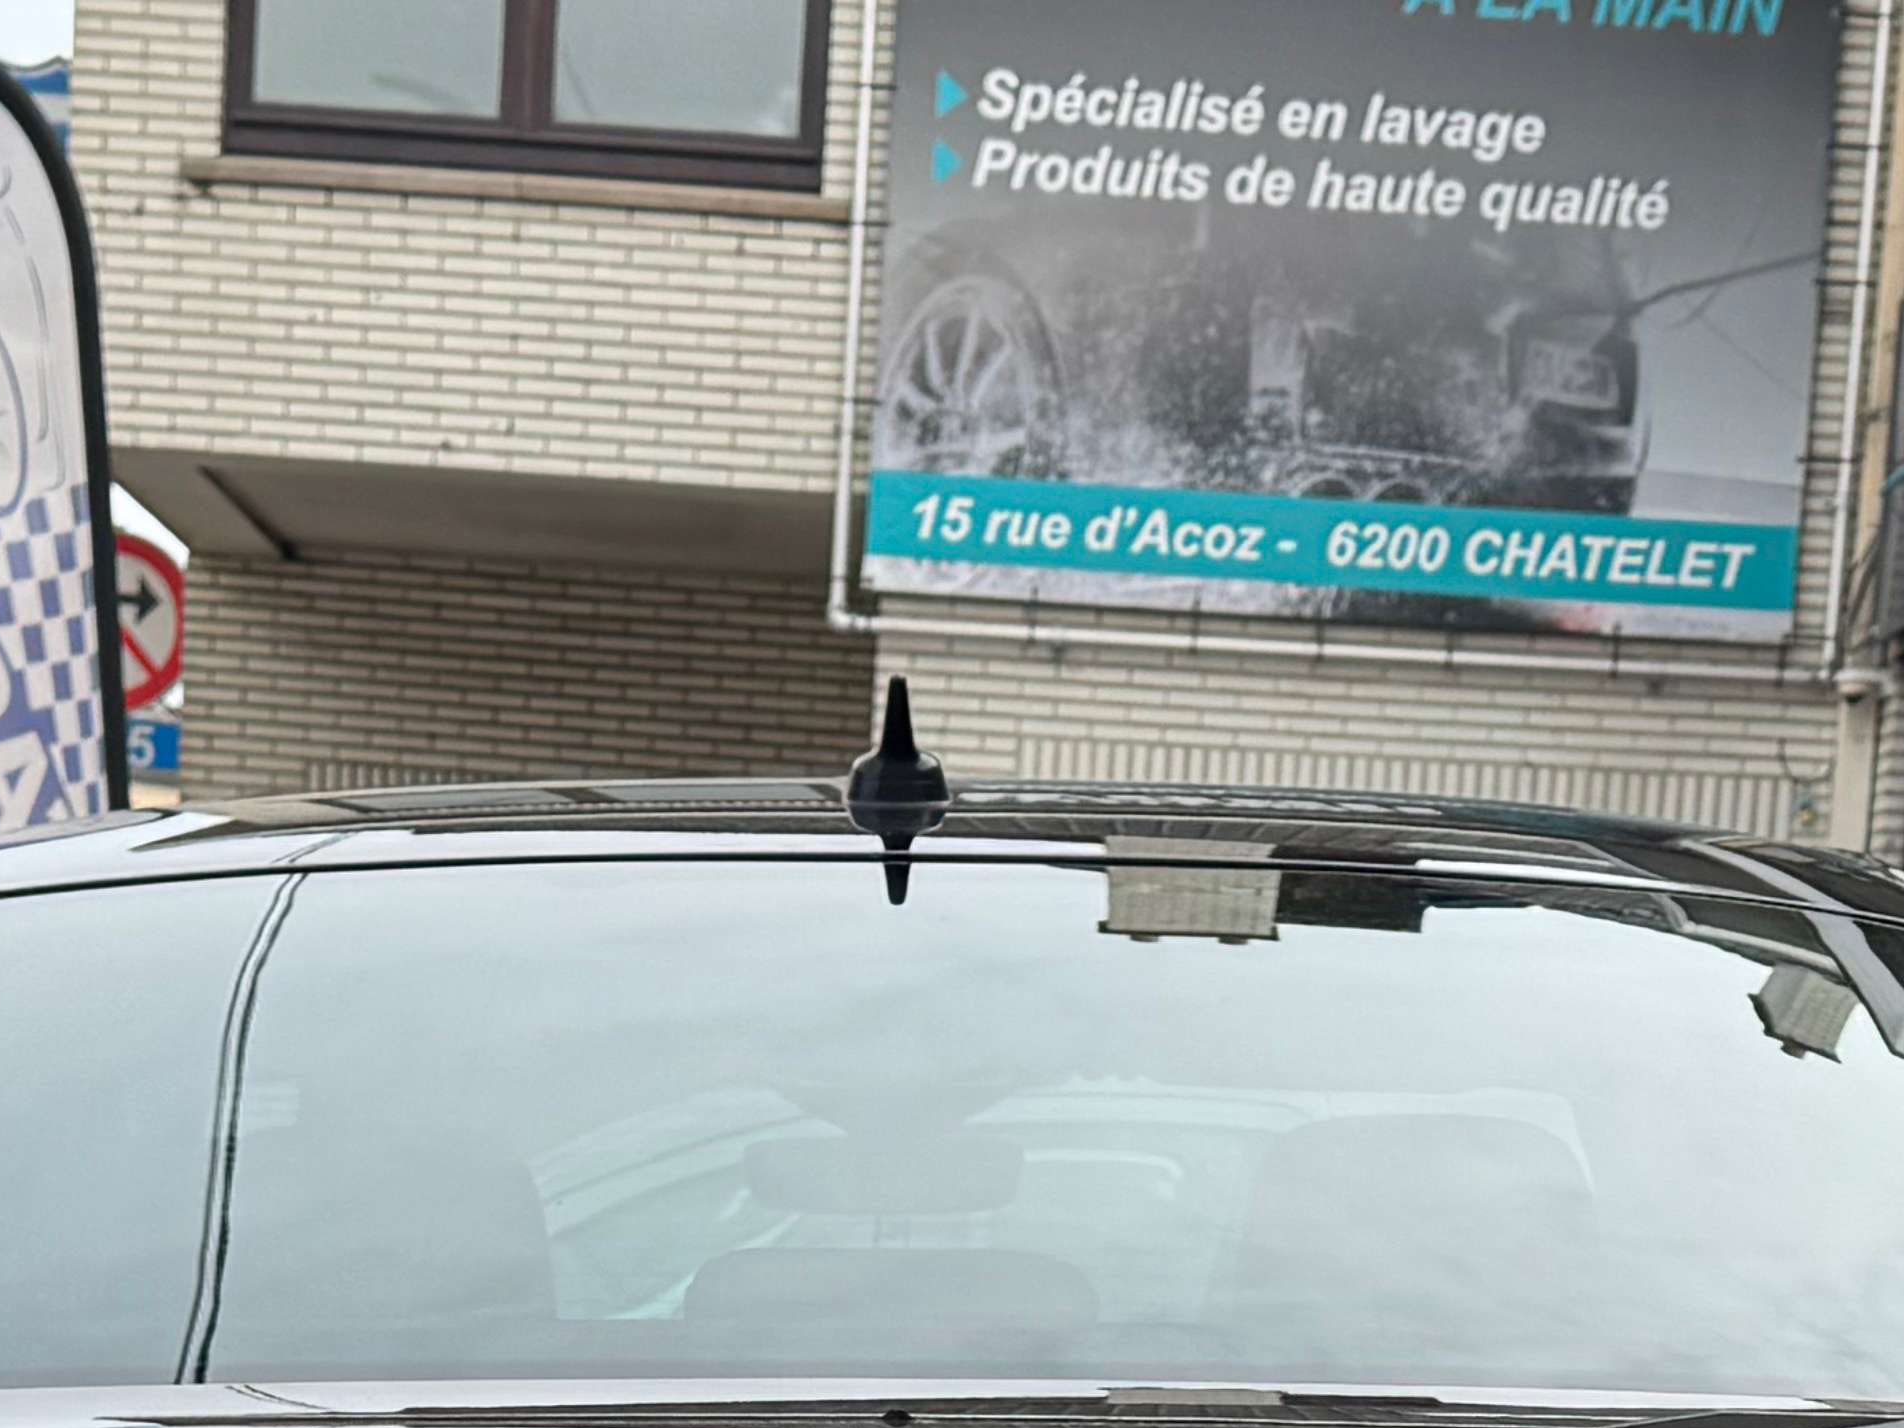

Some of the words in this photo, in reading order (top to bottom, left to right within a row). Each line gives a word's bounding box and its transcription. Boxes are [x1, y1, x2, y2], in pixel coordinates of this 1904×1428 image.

[976, 67, 1265, 137] Spécialisé
[1277, 97, 1349, 142] en
[1359, 93, 1546, 162] lavage
[972, 139, 1210, 202] Produits
[1224, 153, 1297, 209] de
[1306, 158, 1467, 218] haute
[1478, 174, 1672, 232] qualité
[911, 493, 974, 543] 15
[983, 510, 1072, 551] rue
[1326, 521, 1450, 575] 6200
[1460, 527, 1756, 592] CHATELET
